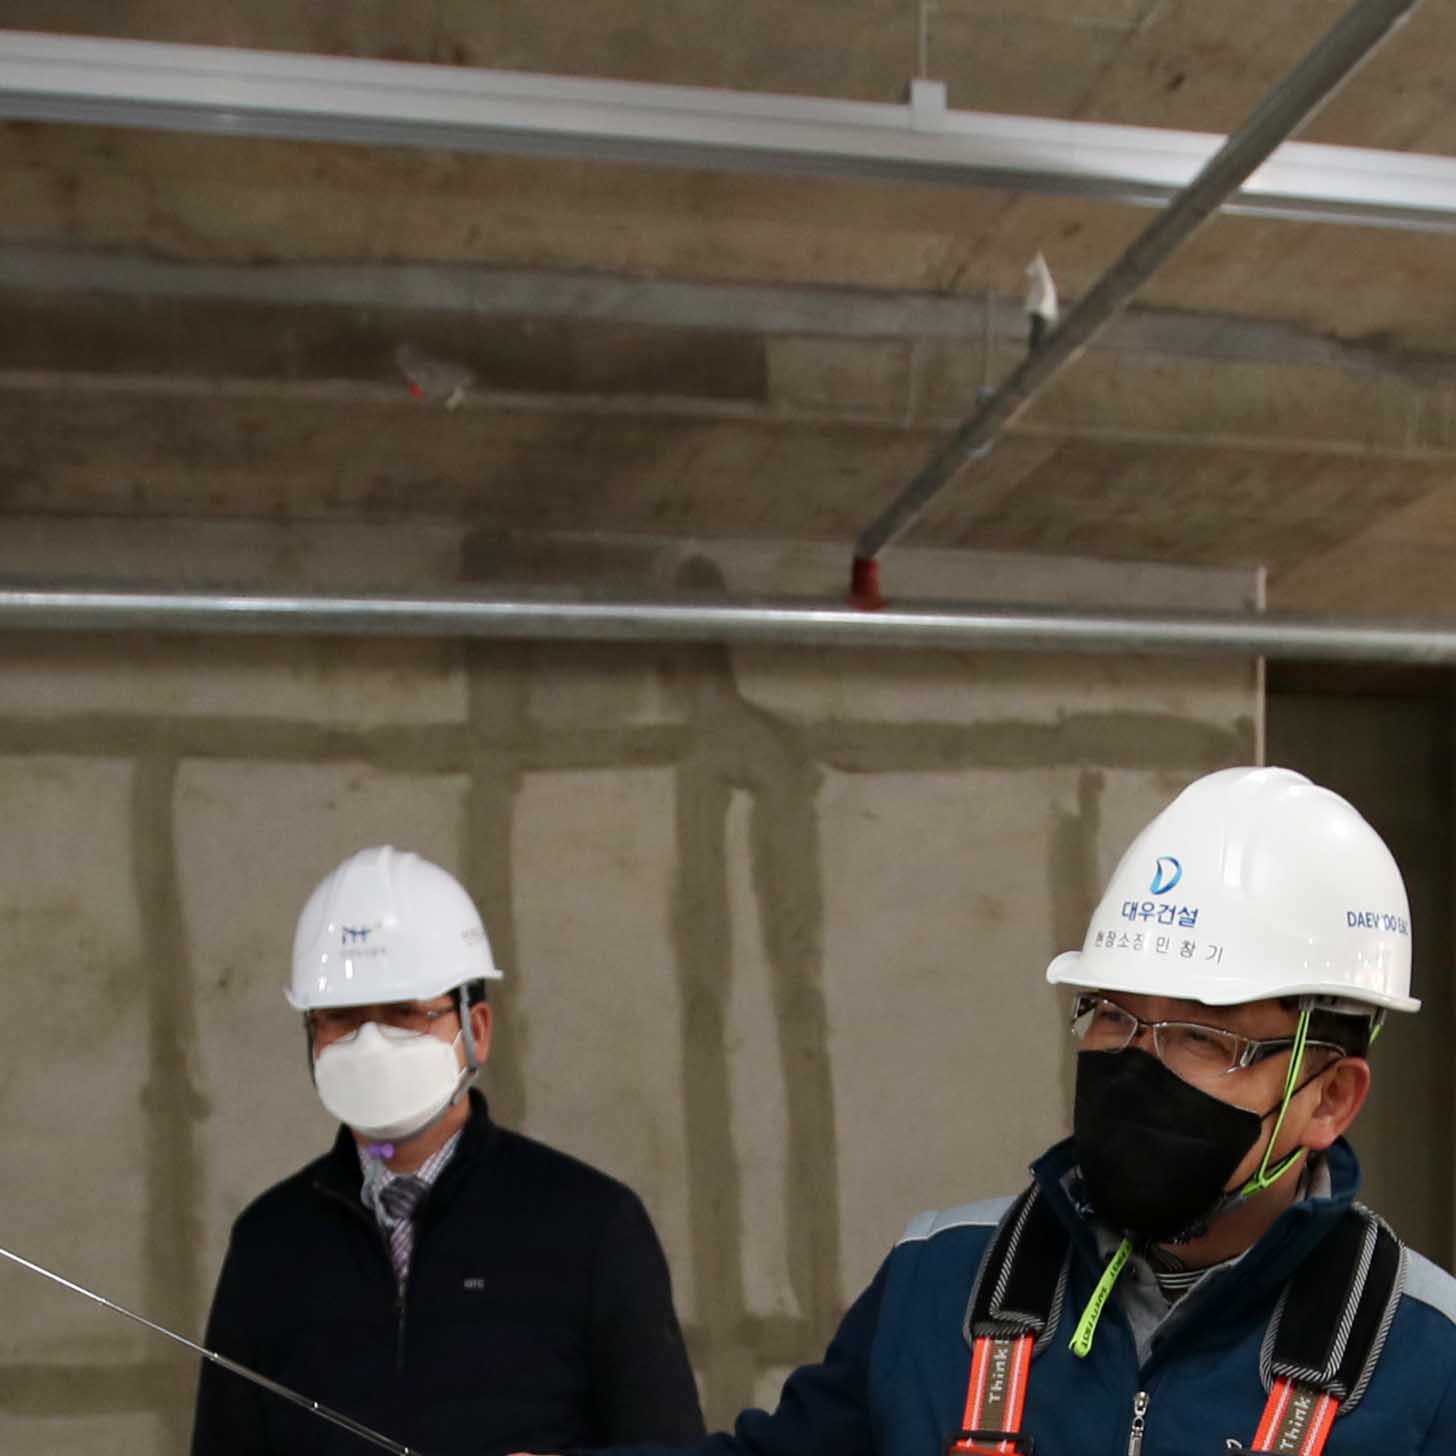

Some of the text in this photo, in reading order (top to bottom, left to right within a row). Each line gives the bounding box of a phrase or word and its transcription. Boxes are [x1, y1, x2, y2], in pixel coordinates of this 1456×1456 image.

[1121, 901, 1200, 929] 대우건설
[988, 1338, 1009, 1404] Think
[1280, 1391, 1313, 1451] Think
